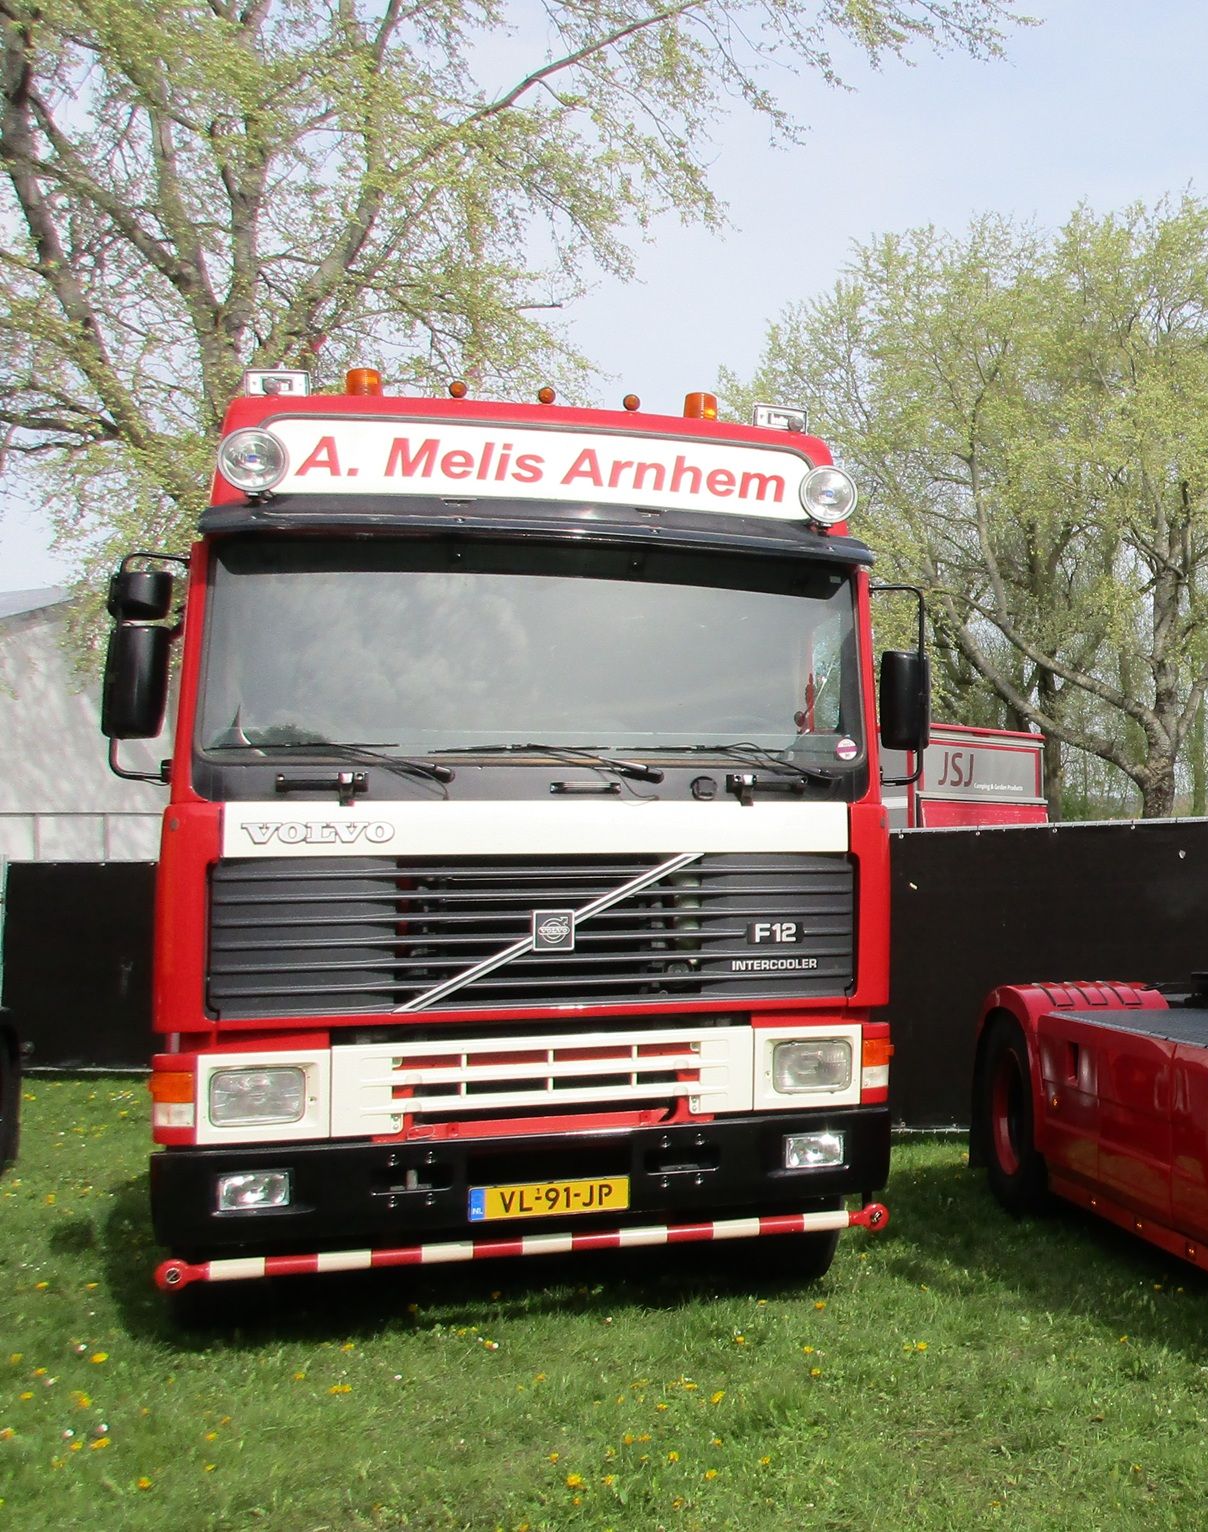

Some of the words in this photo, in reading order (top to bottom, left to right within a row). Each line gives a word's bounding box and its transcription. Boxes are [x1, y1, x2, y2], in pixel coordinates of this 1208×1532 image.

[295, 436, 359, 477] A.
[385, 437, 545, 484] Melis
[561, 448, 787, 503] Arnhem
[937, 751, 974, 787] JSJ
[240, 821, 396, 845] VOLVO
[540, 926, 569, 935] VOLVO
[754, 922, 797, 943] F12
[731, 958, 818, 971] INTERCOOLER
[471, 1207, 484, 1216] NL
[500, 1183, 613, 1214] VL-91-JP
